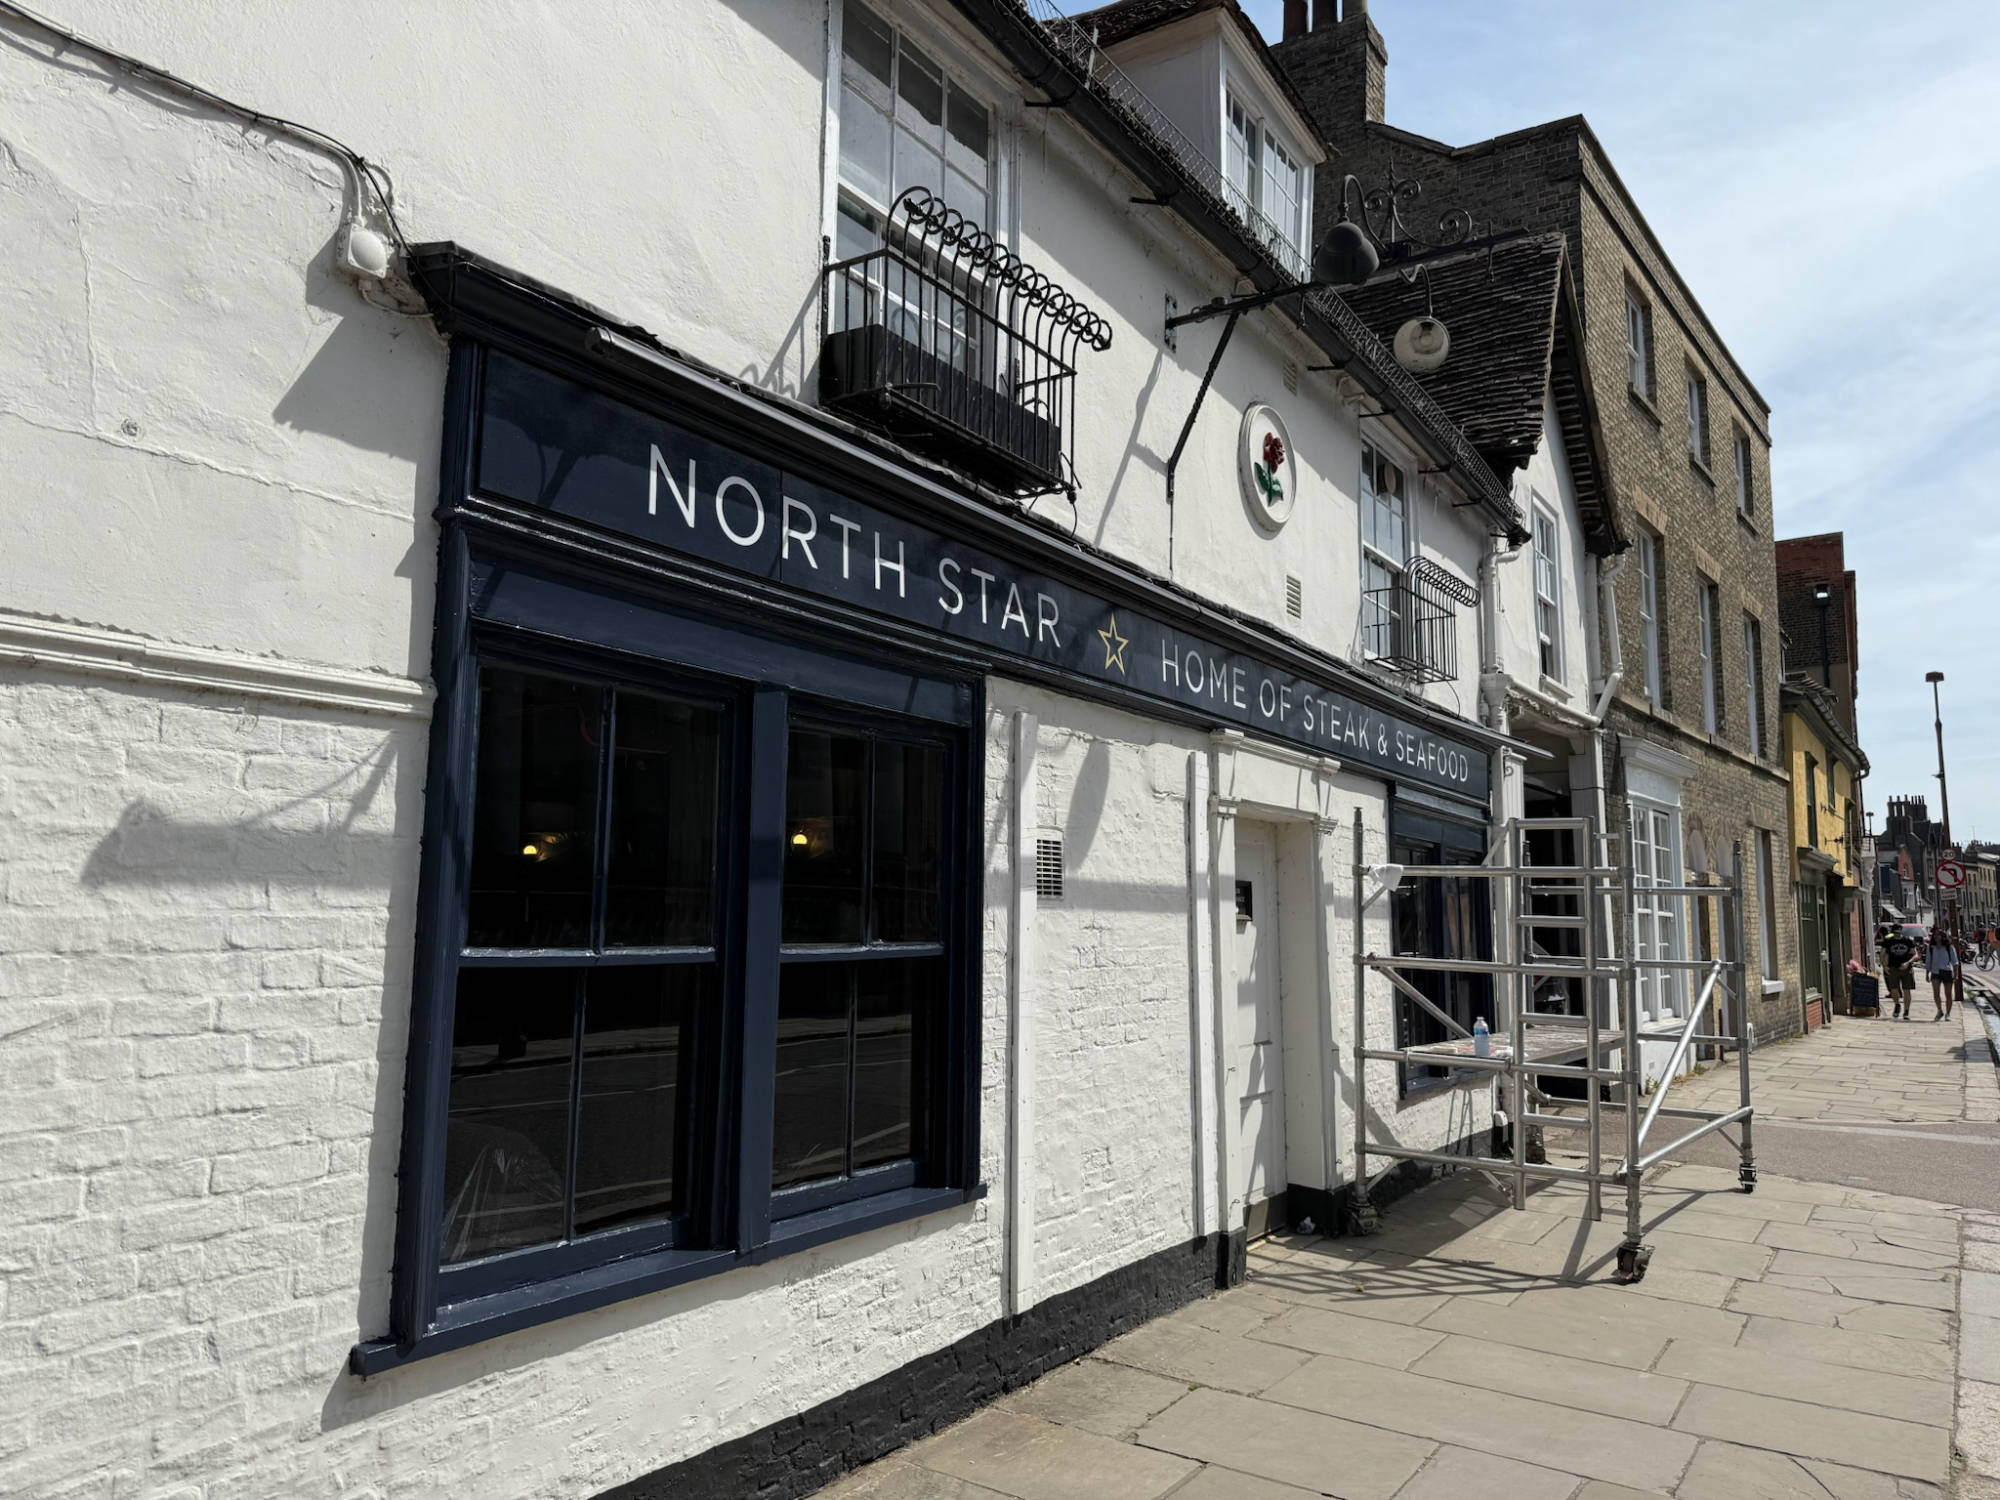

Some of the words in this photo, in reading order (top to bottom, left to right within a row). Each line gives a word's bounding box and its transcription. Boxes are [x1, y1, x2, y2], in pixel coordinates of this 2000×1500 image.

[648, 443, 905, 597] NORTH
[938, 557, 1060, 648] STAR
[1162, 640, 1247, 709] HOME
[1259, 678, 1292, 721] OF
[1303, 694, 1370, 750] STEAK
[1377, 723, 1389, 756] &
[1396, 731, 1468, 783] SEAFOOD
